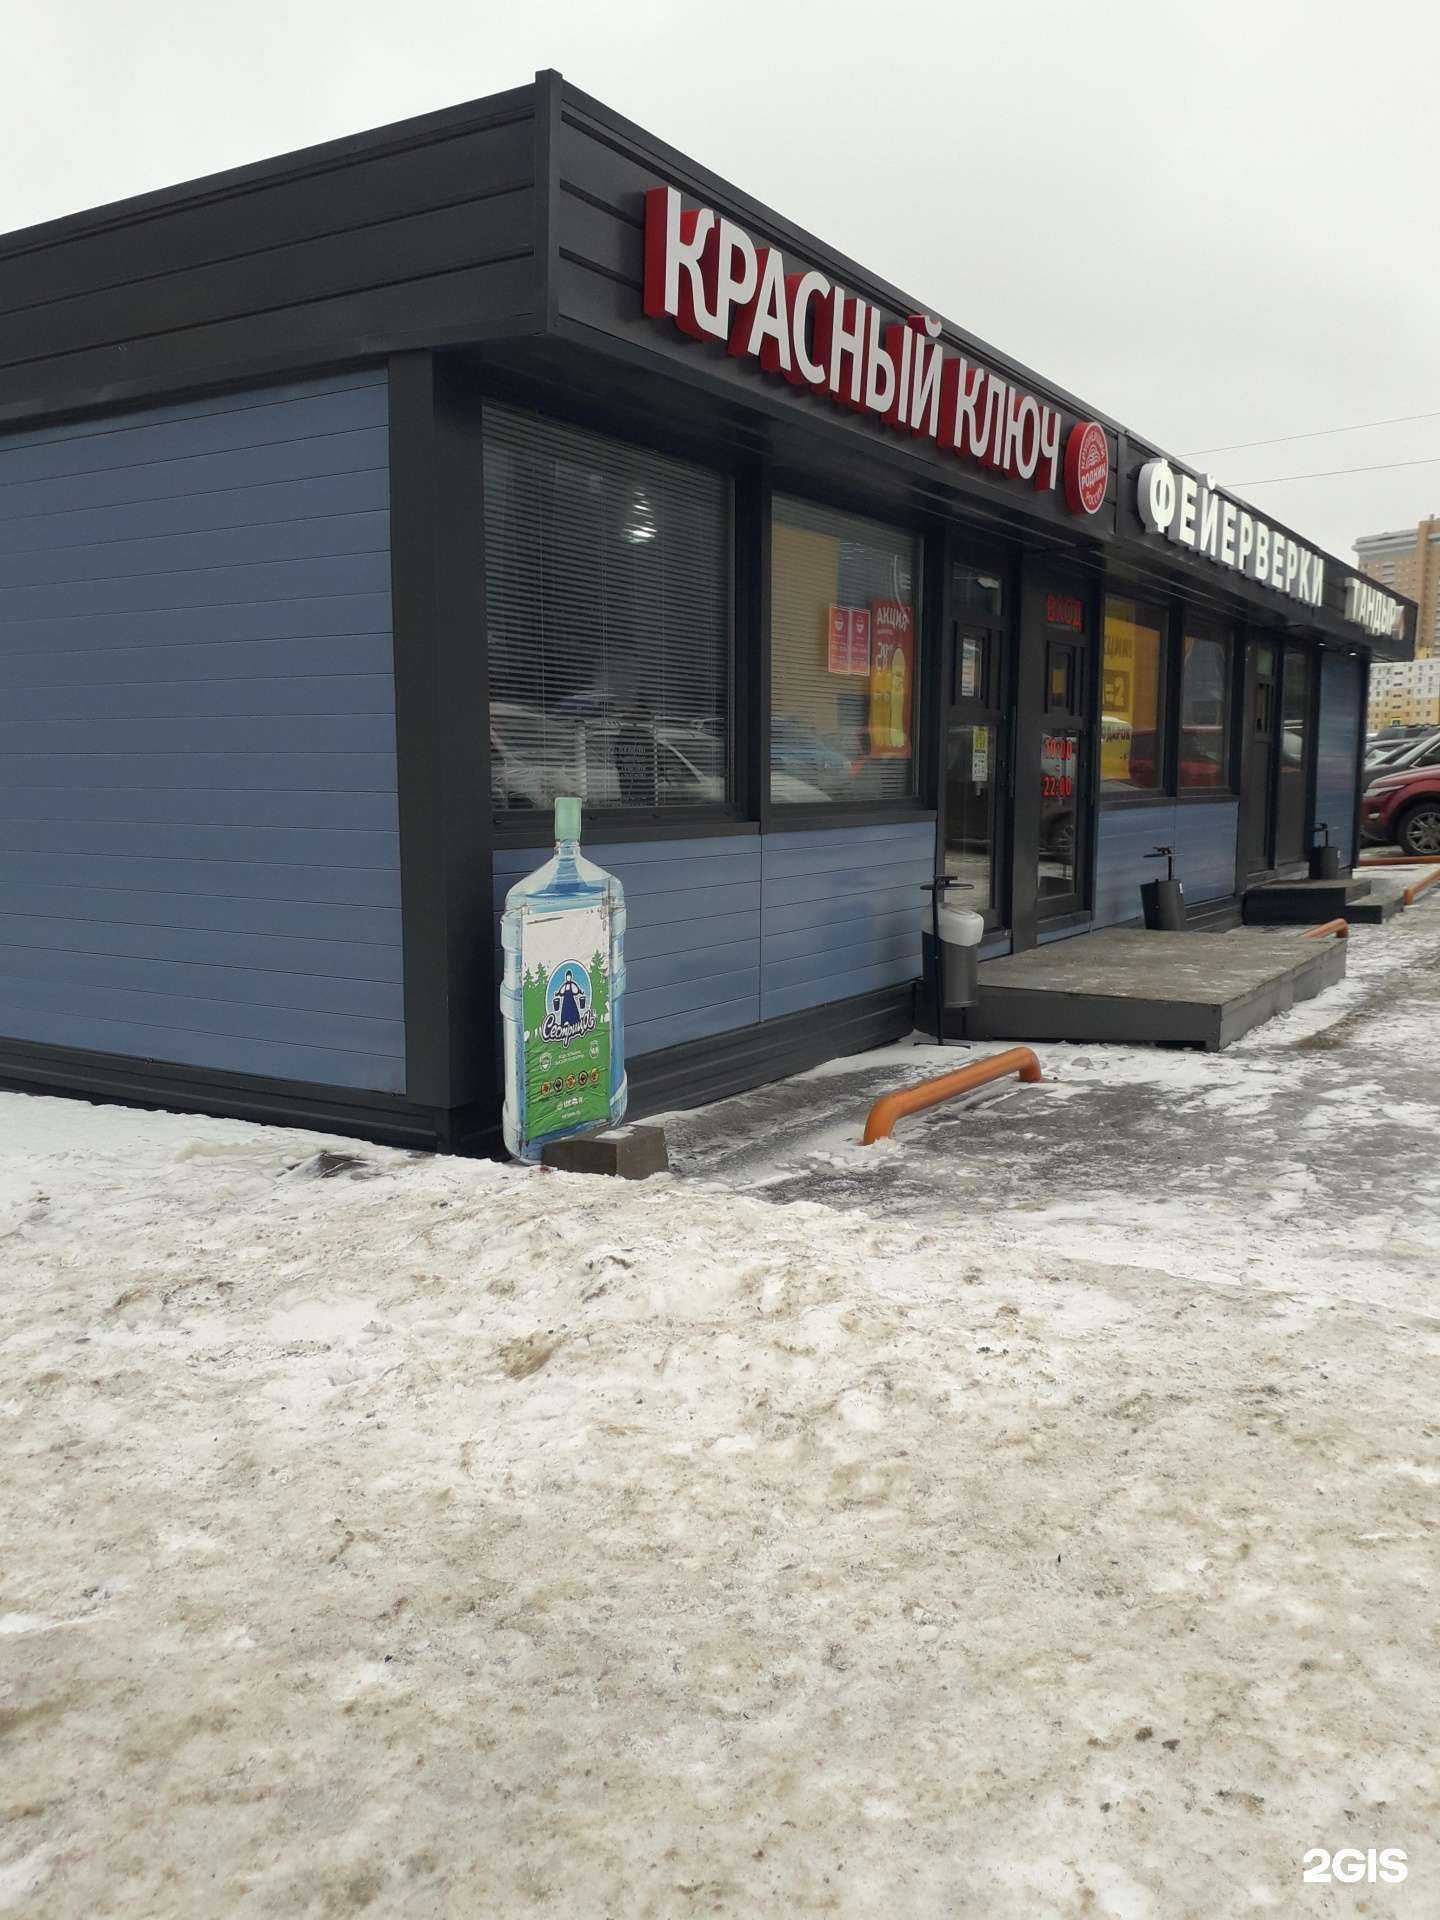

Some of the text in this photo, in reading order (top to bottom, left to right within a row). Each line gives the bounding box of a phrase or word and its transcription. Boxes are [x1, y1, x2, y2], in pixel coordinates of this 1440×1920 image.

[656, 186, 1062, 490] КРАСНЫЙ КЛЮЧ
[1081, 464, 1106, 489] РОДНИК
[1144, 458, 1324, 607] ФЕЙЕРВЕРКИ
[877, 607, 910, 632] АКЦИЯ
[1041, 776, 1072, 798] 22:00
